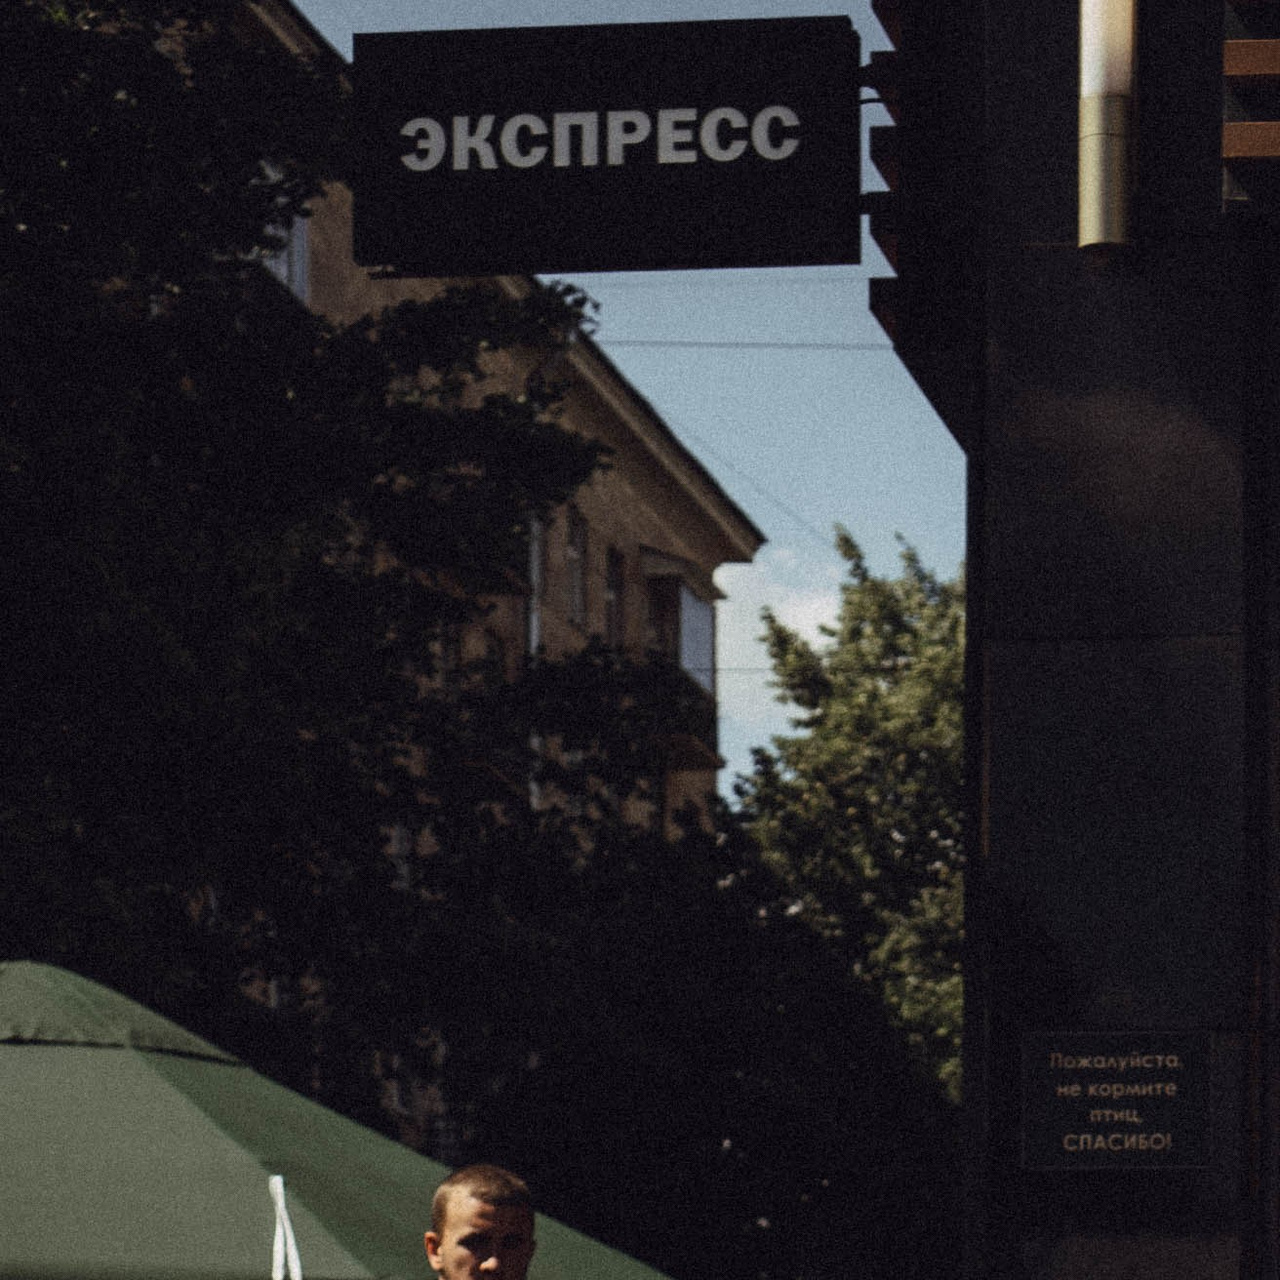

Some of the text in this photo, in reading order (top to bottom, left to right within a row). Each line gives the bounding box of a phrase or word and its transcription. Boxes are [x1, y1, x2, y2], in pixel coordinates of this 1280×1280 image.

[400, 106, 801, 171] ЭКСПРЕСС
[1056, 1082, 1178, 1099] не кормите
[1062, 1133, 1172, 1151] СПАСИБО!
